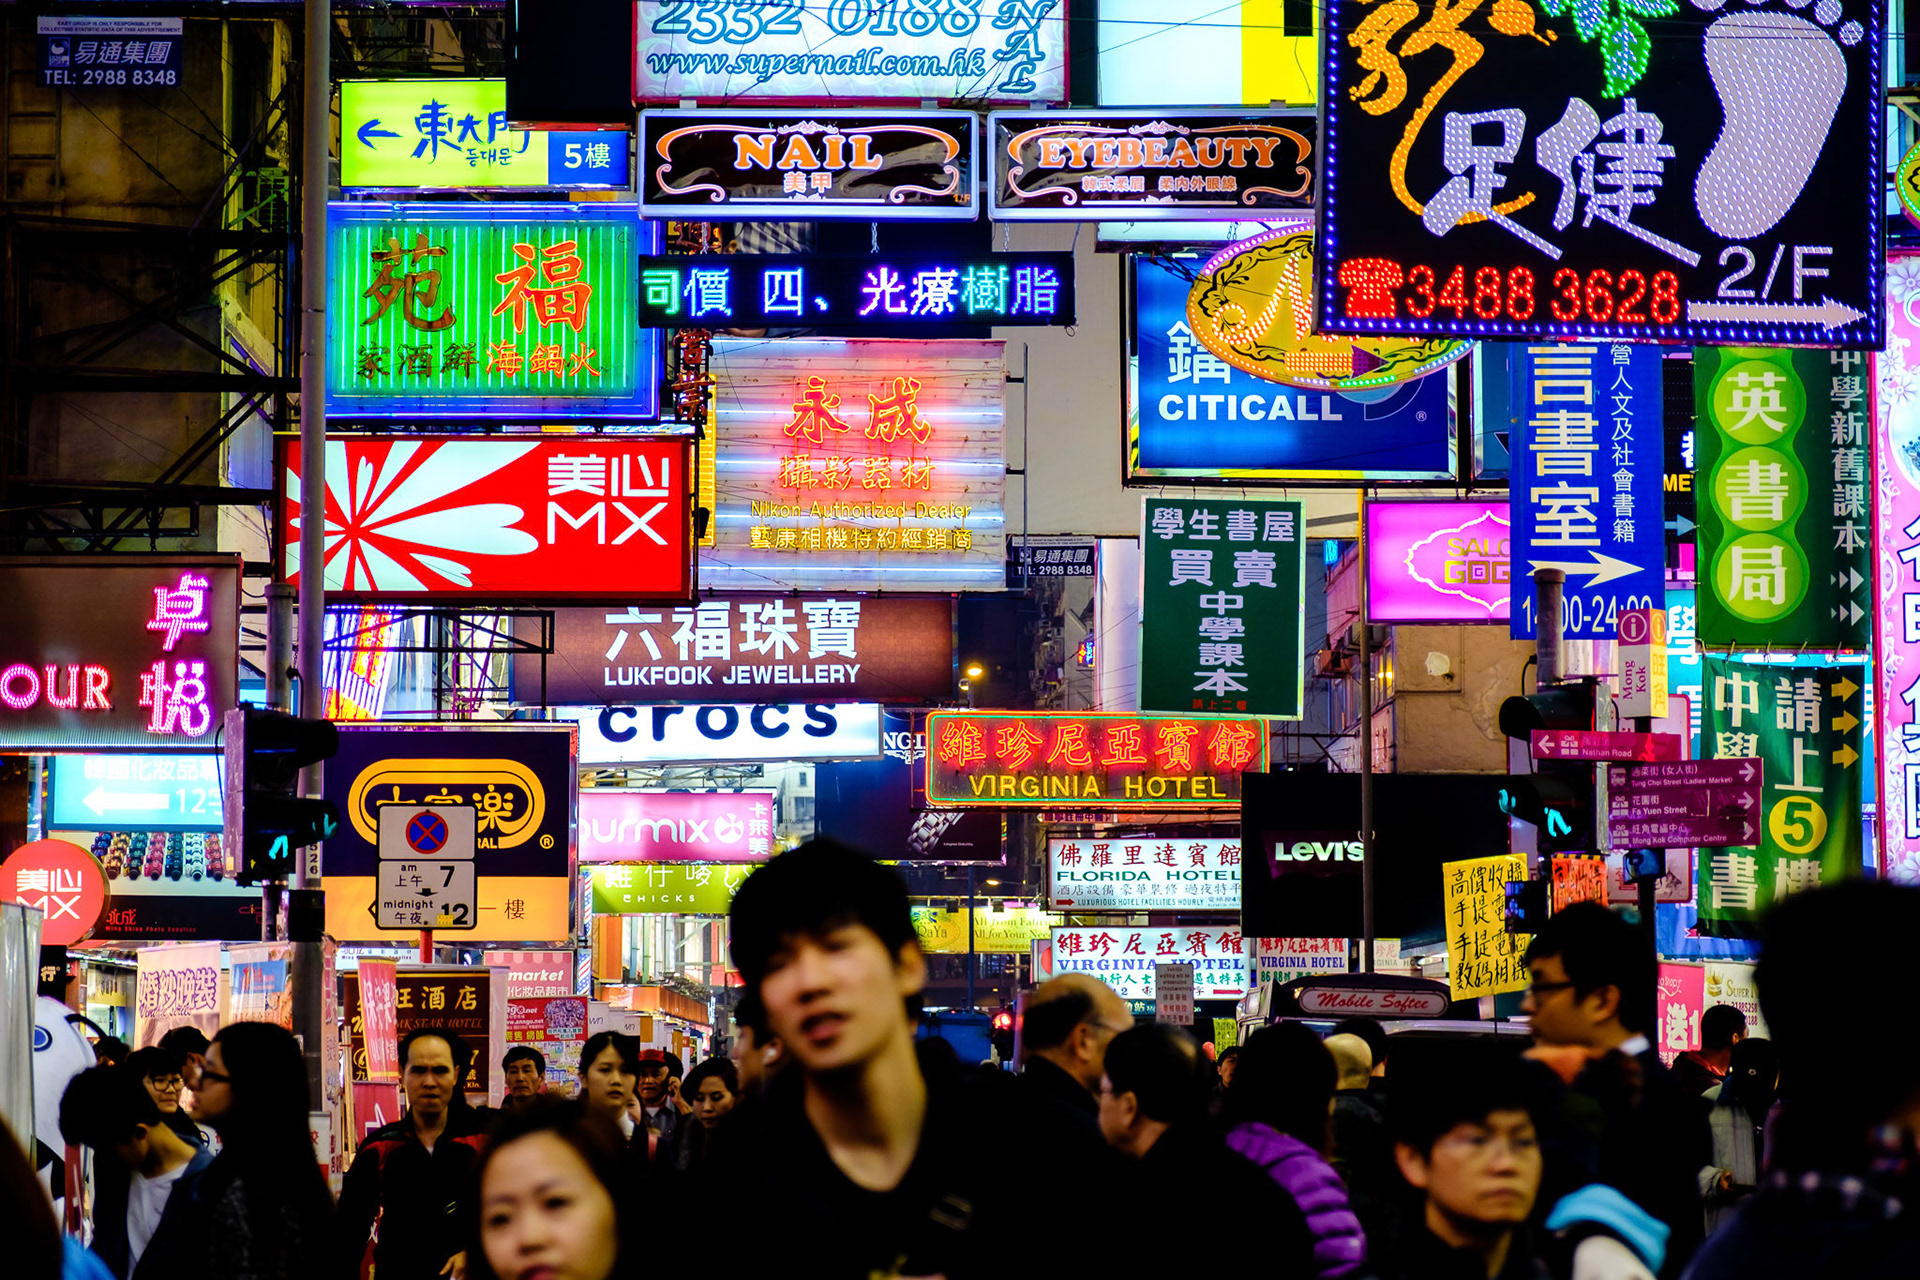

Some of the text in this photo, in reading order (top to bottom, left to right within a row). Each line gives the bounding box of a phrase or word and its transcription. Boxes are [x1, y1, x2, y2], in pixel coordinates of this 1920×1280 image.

[651, 0, 982, 44] 2332 0188
[74, 41, 172, 65] 易通集團
[647, 47, 986, 84] www.supernail.com.hk
[44, 70, 176, 85] TEL: 2988 8348
[410, 98, 531, 165] 東大門
[563, 142, 612, 169] 5樓
[733, 134, 884, 171] NAIL
[1037, 136, 1281, 169] EYEBEAUTY
[784, 171, 834, 194] 美甲
[1422, 97, 1702, 267] 足健
[1716, 244, 1834, 300] 2/F
[1405, 264, 1680, 324] 3488 3628
[783, 375, 932, 444] 永成
[1158, 394, 1343, 421] CITICALL
[547, 453, 669, 497] 美心
[779, 454, 937, 491] 攝影器材
[1725, 371, 1789, 606] 英書局
[810, 500, 907, 519] Authorized
[915, 501, 973, 520] Dealer
[547, 502, 668, 545] MX
[1151, 506, 1295, 543] 學生書屋
[750, 525, 973, 549] 藝康相機特約經銷商
[1033, 549, 1089, 563] 易通集團
[1169, 549, 1278, 588] 買賣
[1039, 565, 1065, 575] 2988
[1066, 565, 1092, 575] 8348
[604, 599, 861, 661] 六福珠寶
[1193, 590, 1249, 697] 中學課本
[603, 664, 861, 687] LUKFOOK JEWELLERY
[1622, 659, 1636, 700] Mong
[1635, 665, 1647, 693] Kok
[1652, 653, 1667, 711] 旺角
[598, 704, 838, 742] crocs
[940, 721, 1257, 771] 維珍尼亞賓館
[1582, 748, 1632, 757] Nathan Road
[1661, 763, 1698, 776] (女人街)
[969, 774, 1227, 798] VIRGINIA HOTEL
[1631, 780, 1646, 789] Tung
[1647, 779, 1662, 787] Choi
[1663, 778, 1682, 787] Street
[1632, 805, 1687, 816] Fa Yuen Street
[748, 801, 769, 855] 卡萊美
[1632, 834, 1727, 846] Mong Kok Computer Centre
[1056, 842, 1241, 868] 佛羅里達賓館
[15, 868, 82, 893] 美心
[394, 874, 423, 888] 上午
[400, 864, 455, 888] am 7
[1056, 870, 1241, 882] FLORIDA HOTEL
[383, 900, 469, 925] midnight 12
[1077, 898, 1204, 906] LUXURIOUS HOTEL FACILITIES HOURLY
[394, 912, 422, 925] 午夜
[1004, 929, 1027, 939] Your
[1057, 931, 1245, 957] 維珍尼亞賓館
[1057, 959, 1155, 971] VIRGINIA
[1260, 956, 1345, 968] VIRGINIA HOTEL
[1455, 955, 1528, 992] 數碼相機
[139, 966, 218, 1010] 婚紗晚裝
[507, 969, 564, 982] market
[1726, 979, 1750, 998] SUPER
[507, 986, 569, 998] 化妝品超市
[1316, 992, 1429, 1012] Mobile Softee
